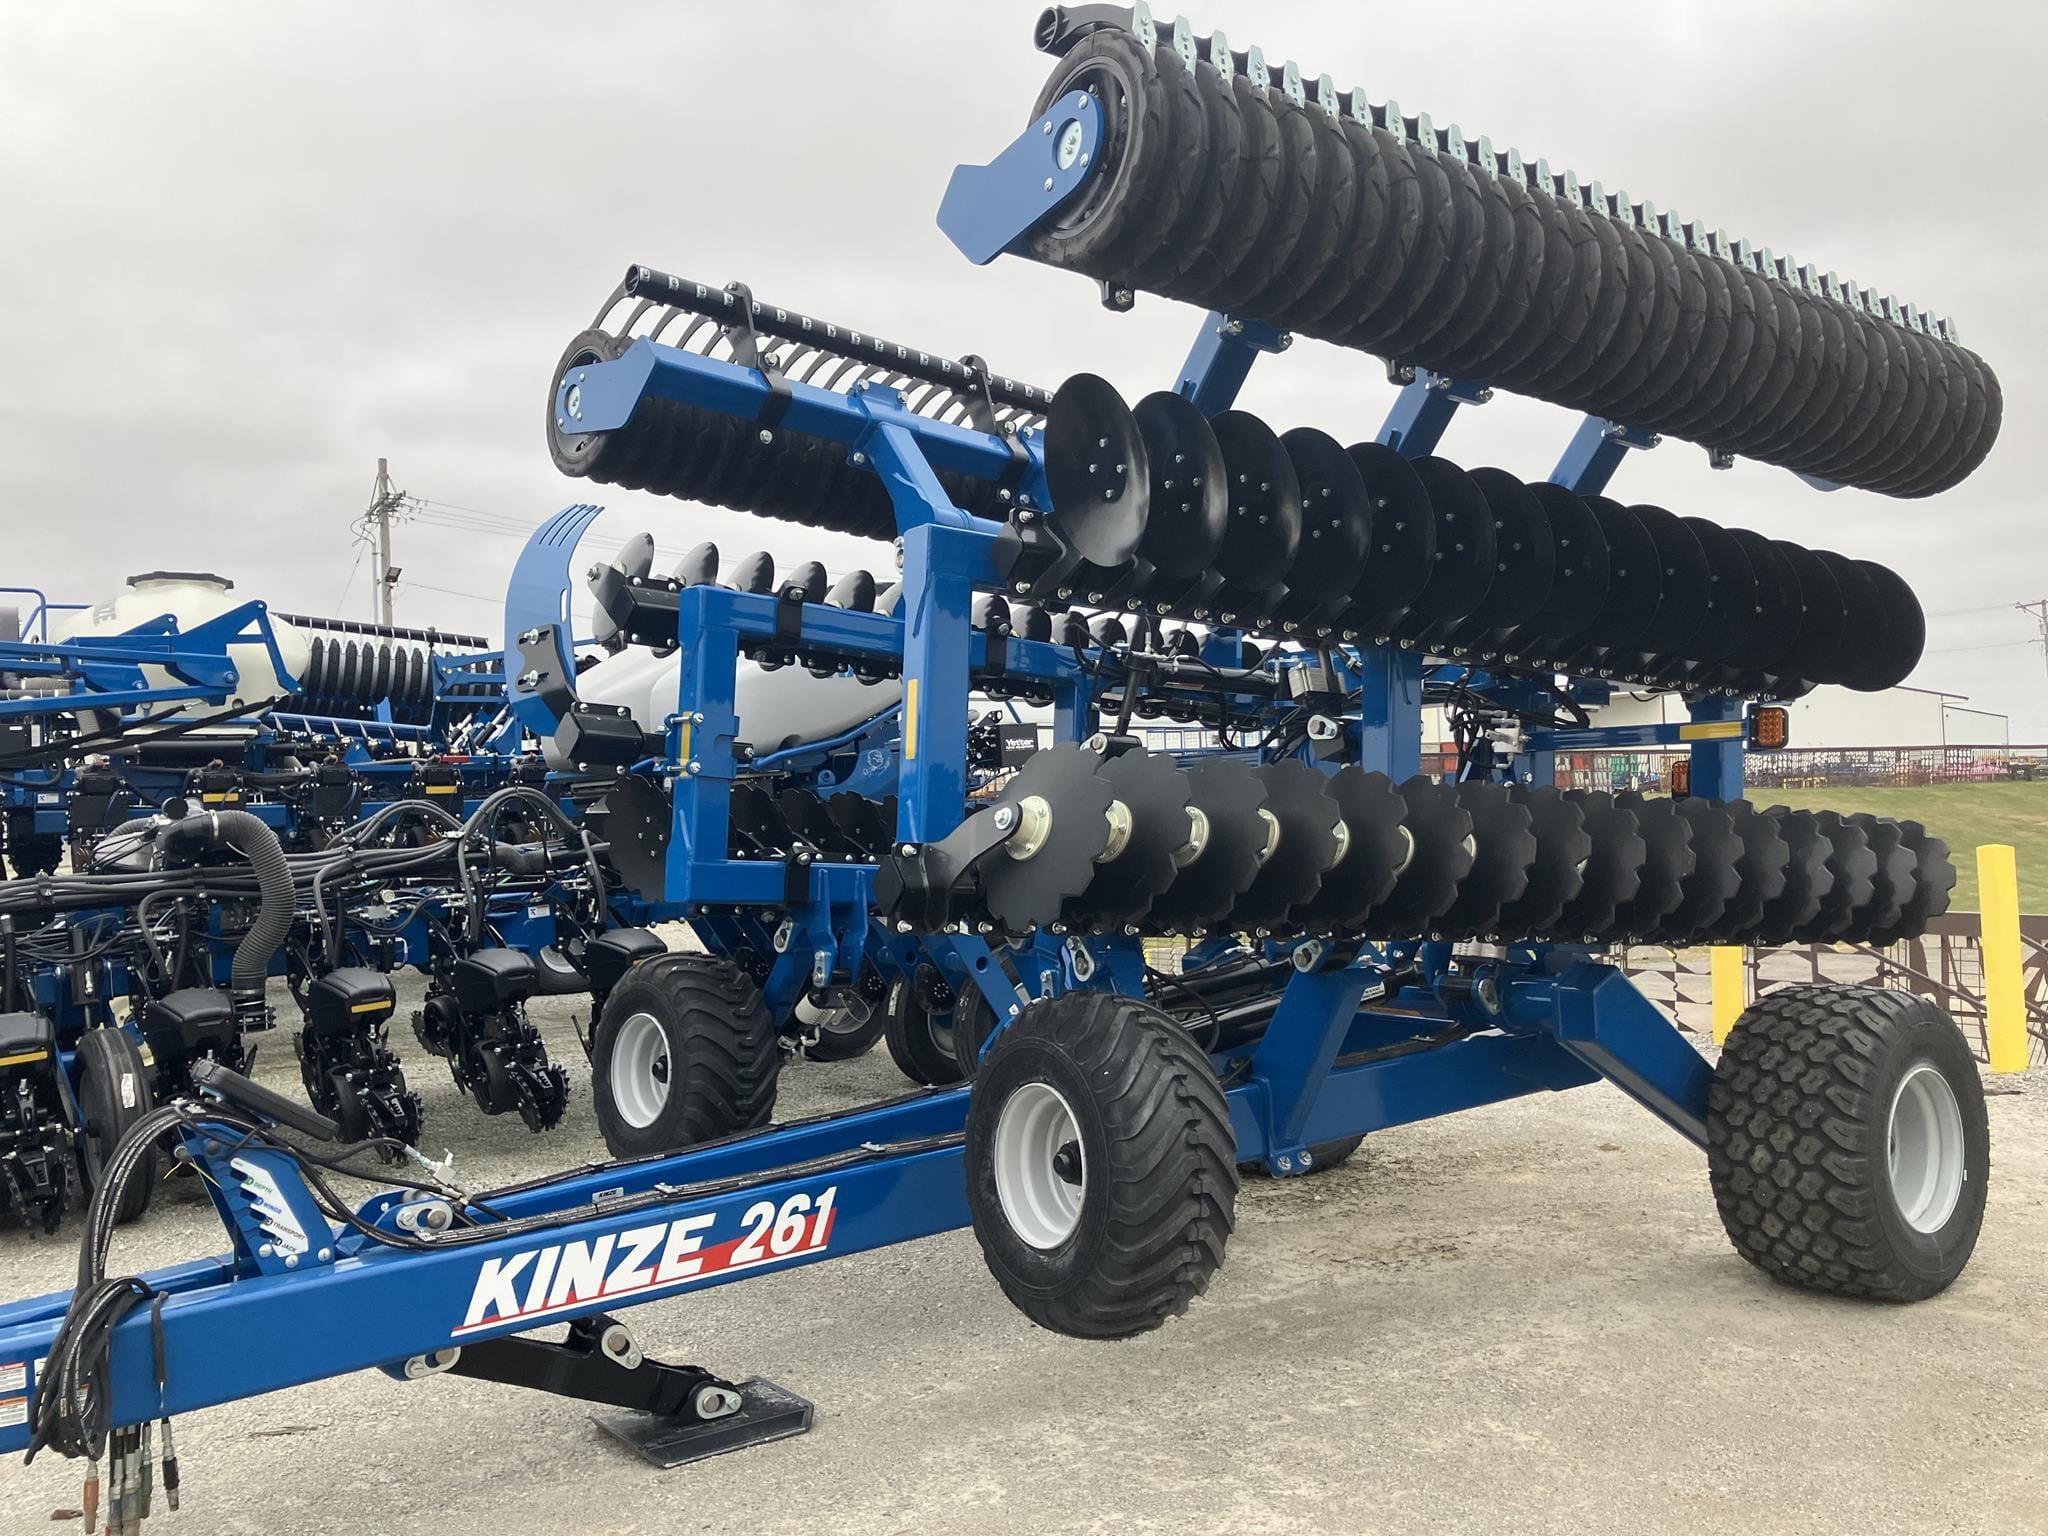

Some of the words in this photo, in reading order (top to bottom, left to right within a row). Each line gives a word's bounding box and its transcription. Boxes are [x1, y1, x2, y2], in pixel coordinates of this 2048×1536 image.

[273, 1222, 305, 1240] TRANSPORT
[281, 1243, 297, 1252] JACK
[464, 1213, 716, 1325] KINZE
[729, 1186, 837, 1265] 261
